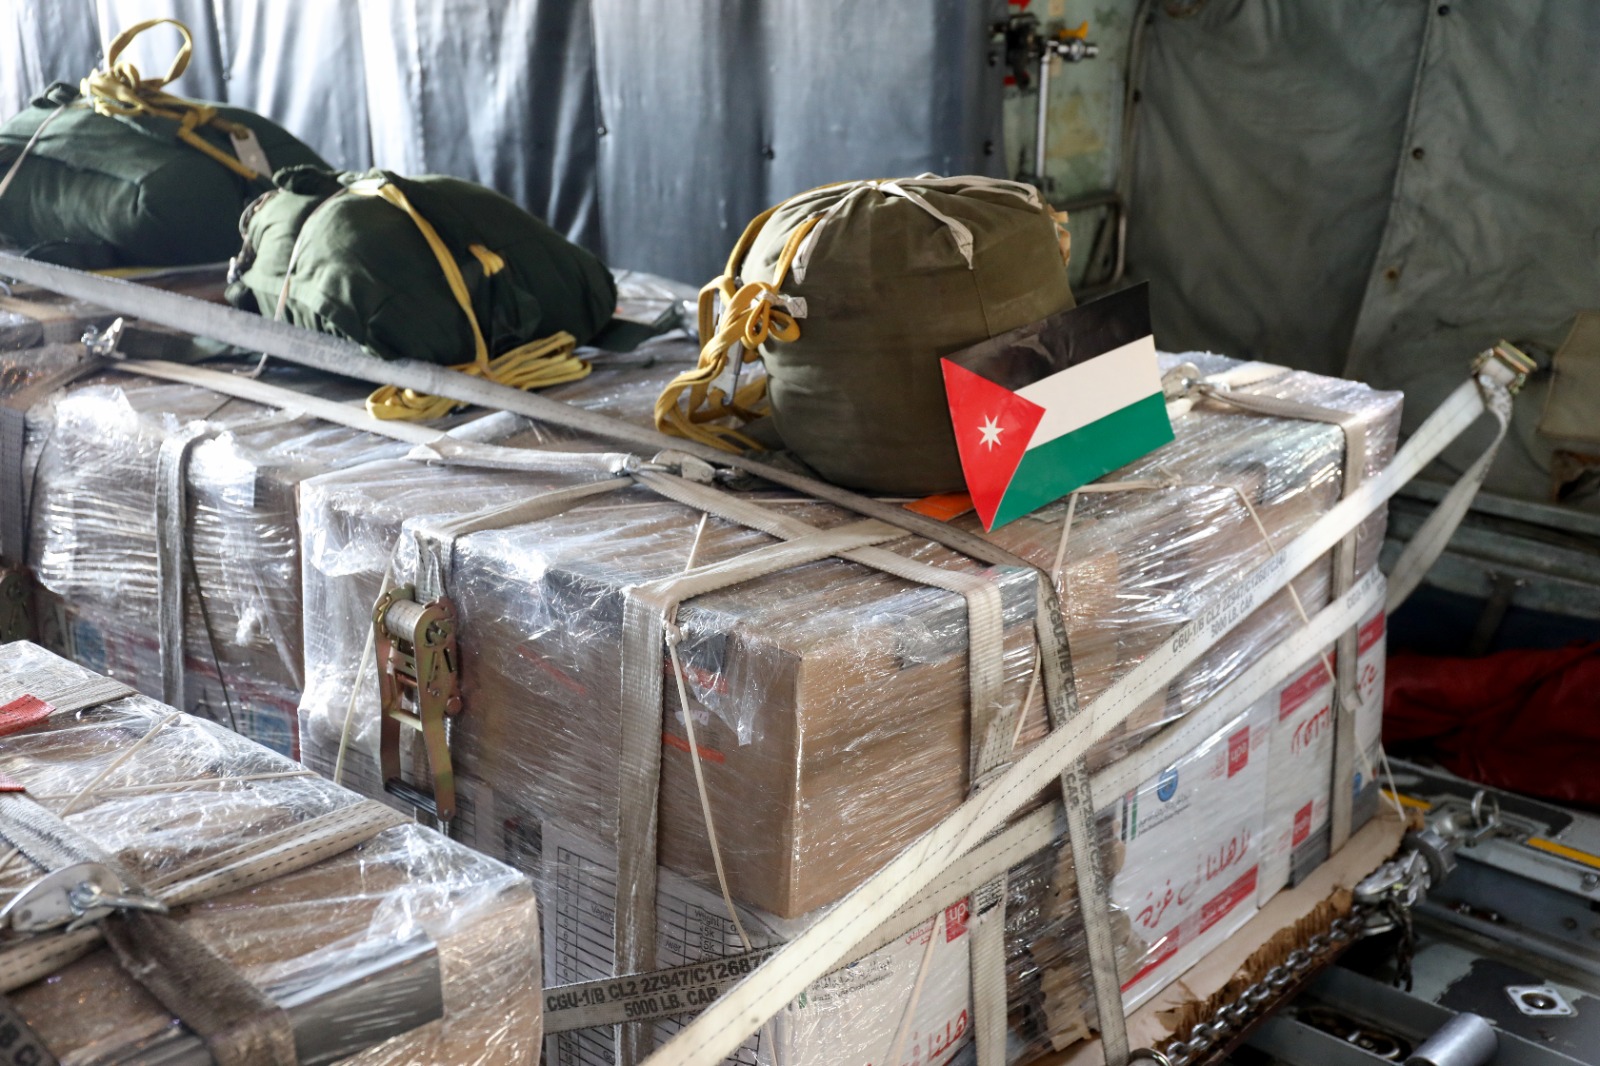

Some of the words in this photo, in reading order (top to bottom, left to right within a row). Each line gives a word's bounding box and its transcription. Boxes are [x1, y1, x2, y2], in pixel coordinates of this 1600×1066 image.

[1172, 617, 1205, 653] CGU-1/B
[1206, 604, 1221, 625] CL2
[1046, 596, 1071, 673] CGU-1/B
[1064, 677, 1079, 713] CL2
[1066, 772, 1080, 811] CAP.
[950, 902, 968, 923] up
[546, 988, 606, 1012] CGU-1/B
[608, 982, 638, 1000] CL2
[624, 999, 658, 1018] 5000
[661, 993, 685, 1011] LB.
